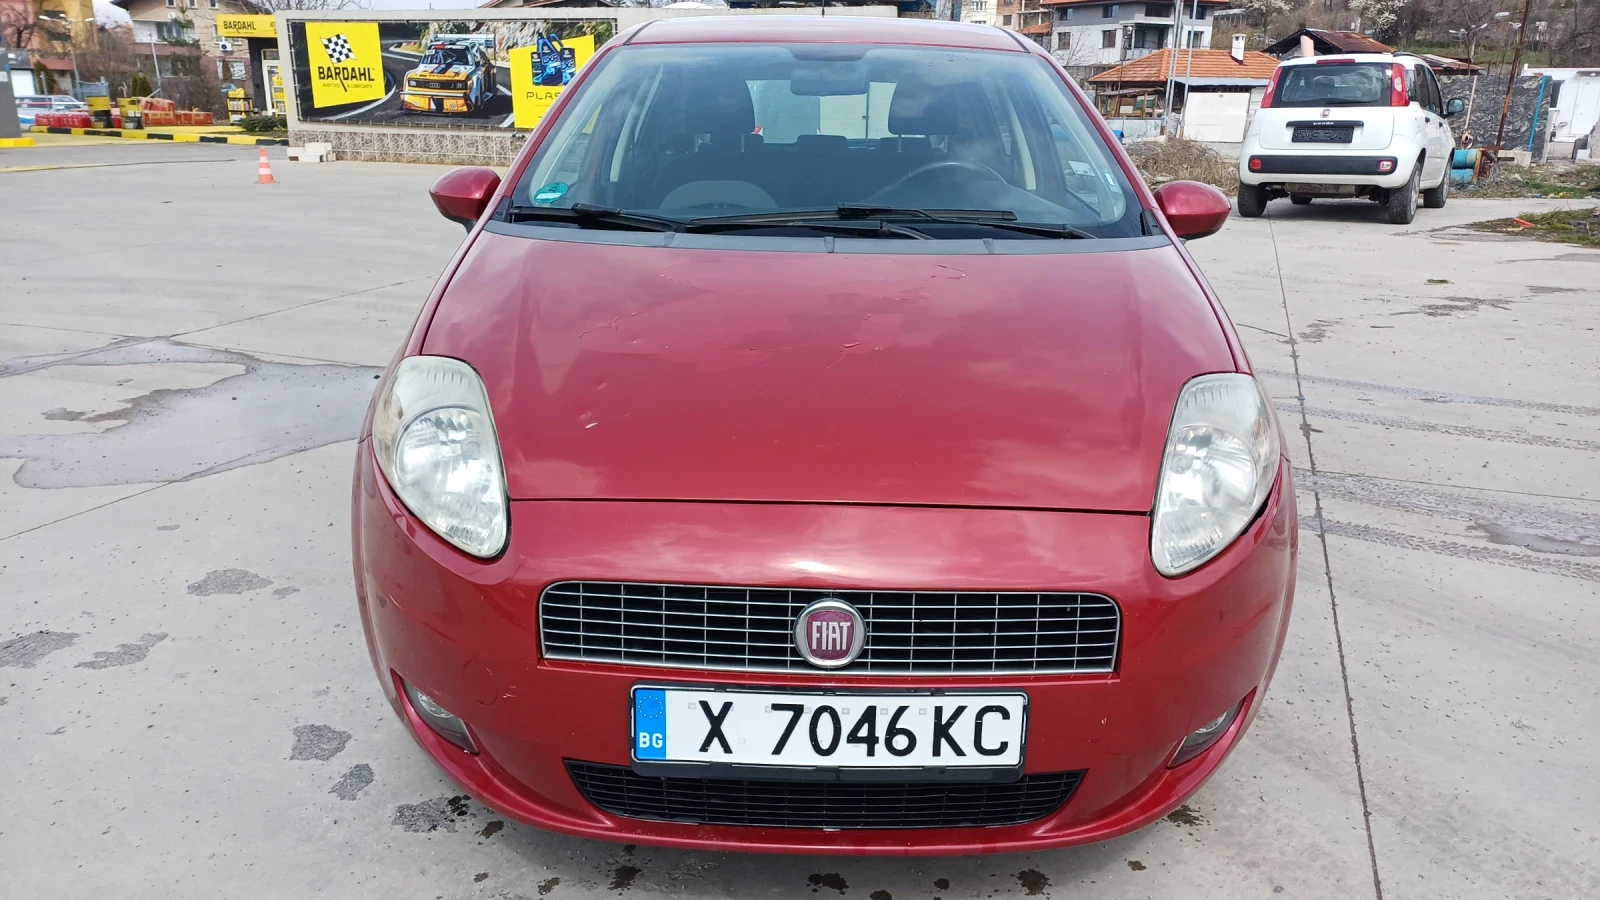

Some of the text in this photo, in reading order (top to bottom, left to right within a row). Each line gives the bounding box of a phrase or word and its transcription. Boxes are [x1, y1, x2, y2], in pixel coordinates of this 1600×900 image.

[223, 20, 257, 33] BARDAHL
[317, 66, 375, 83] BARDAHL
[811, 621, 851, 651] FIAT
[698, 700, 1011, 757] X 7046 KC
[638, 732, 664, 749] BG
